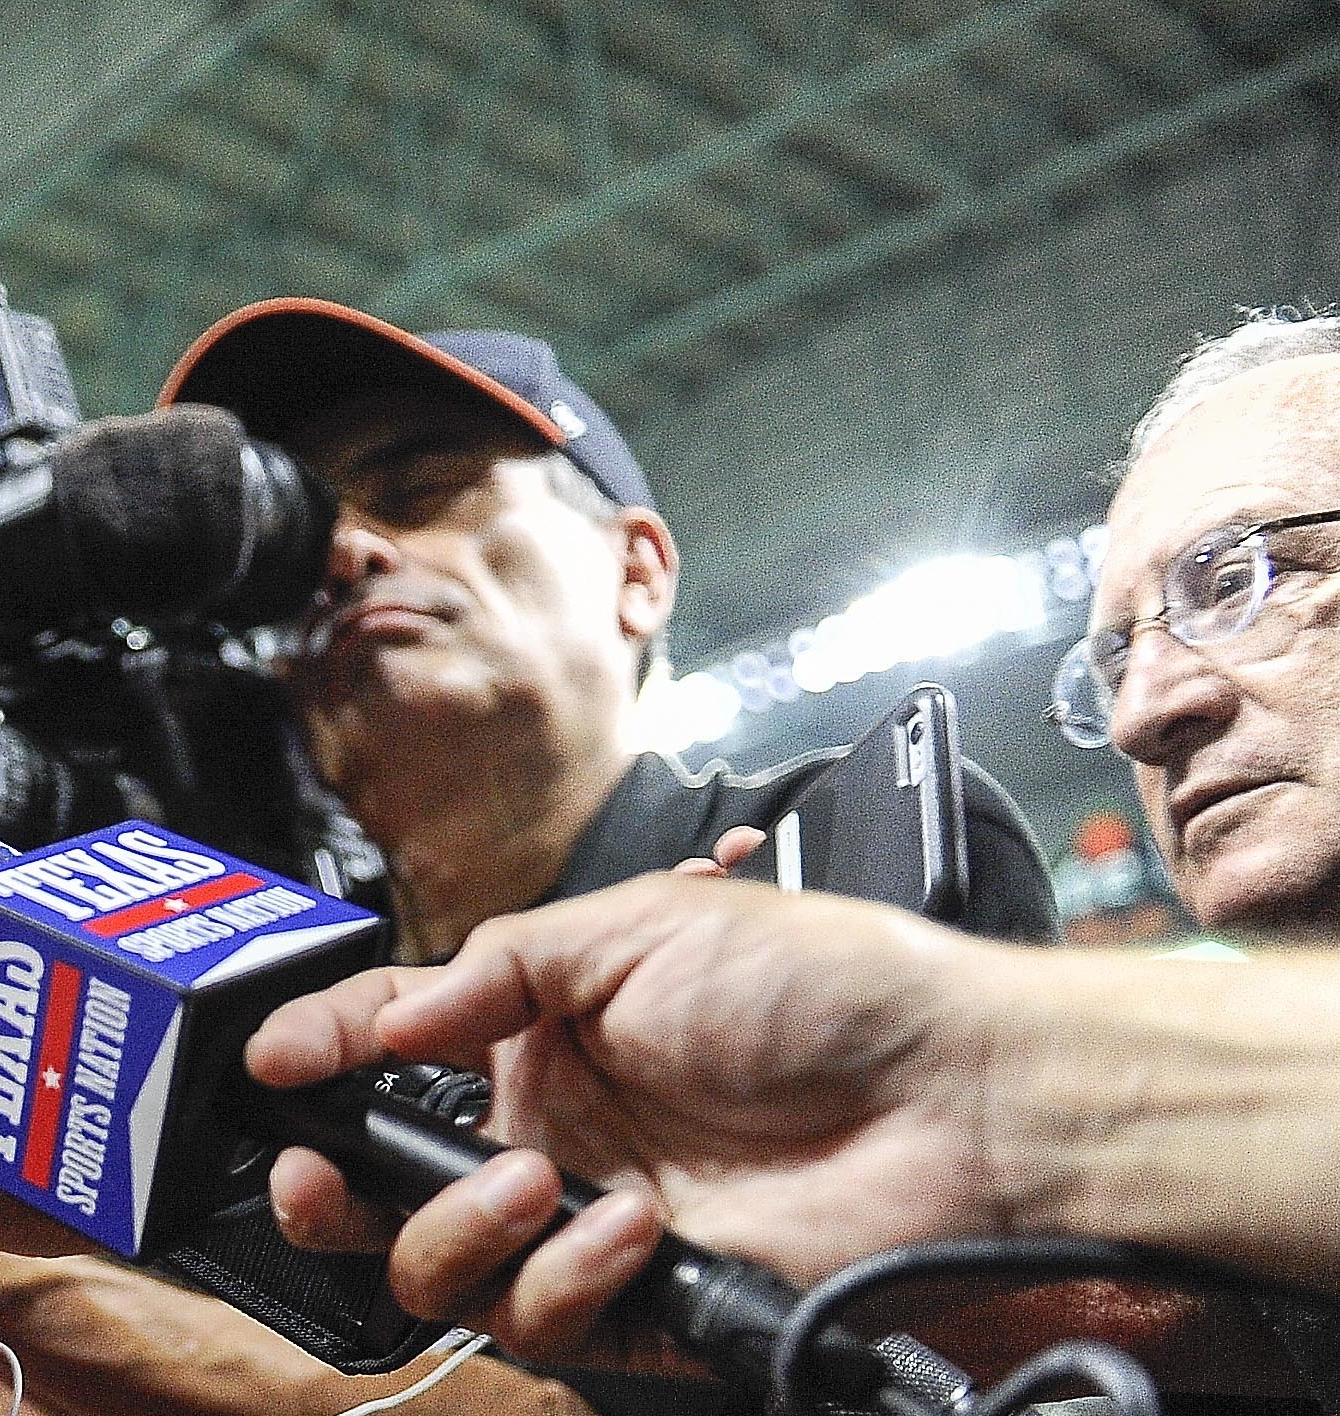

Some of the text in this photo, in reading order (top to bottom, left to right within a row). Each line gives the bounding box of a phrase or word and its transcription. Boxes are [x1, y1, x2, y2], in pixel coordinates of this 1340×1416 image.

[116, 885, 318, 963] SPORTS NATION
[56, 976, 133, 1215] SPORTS NATION
